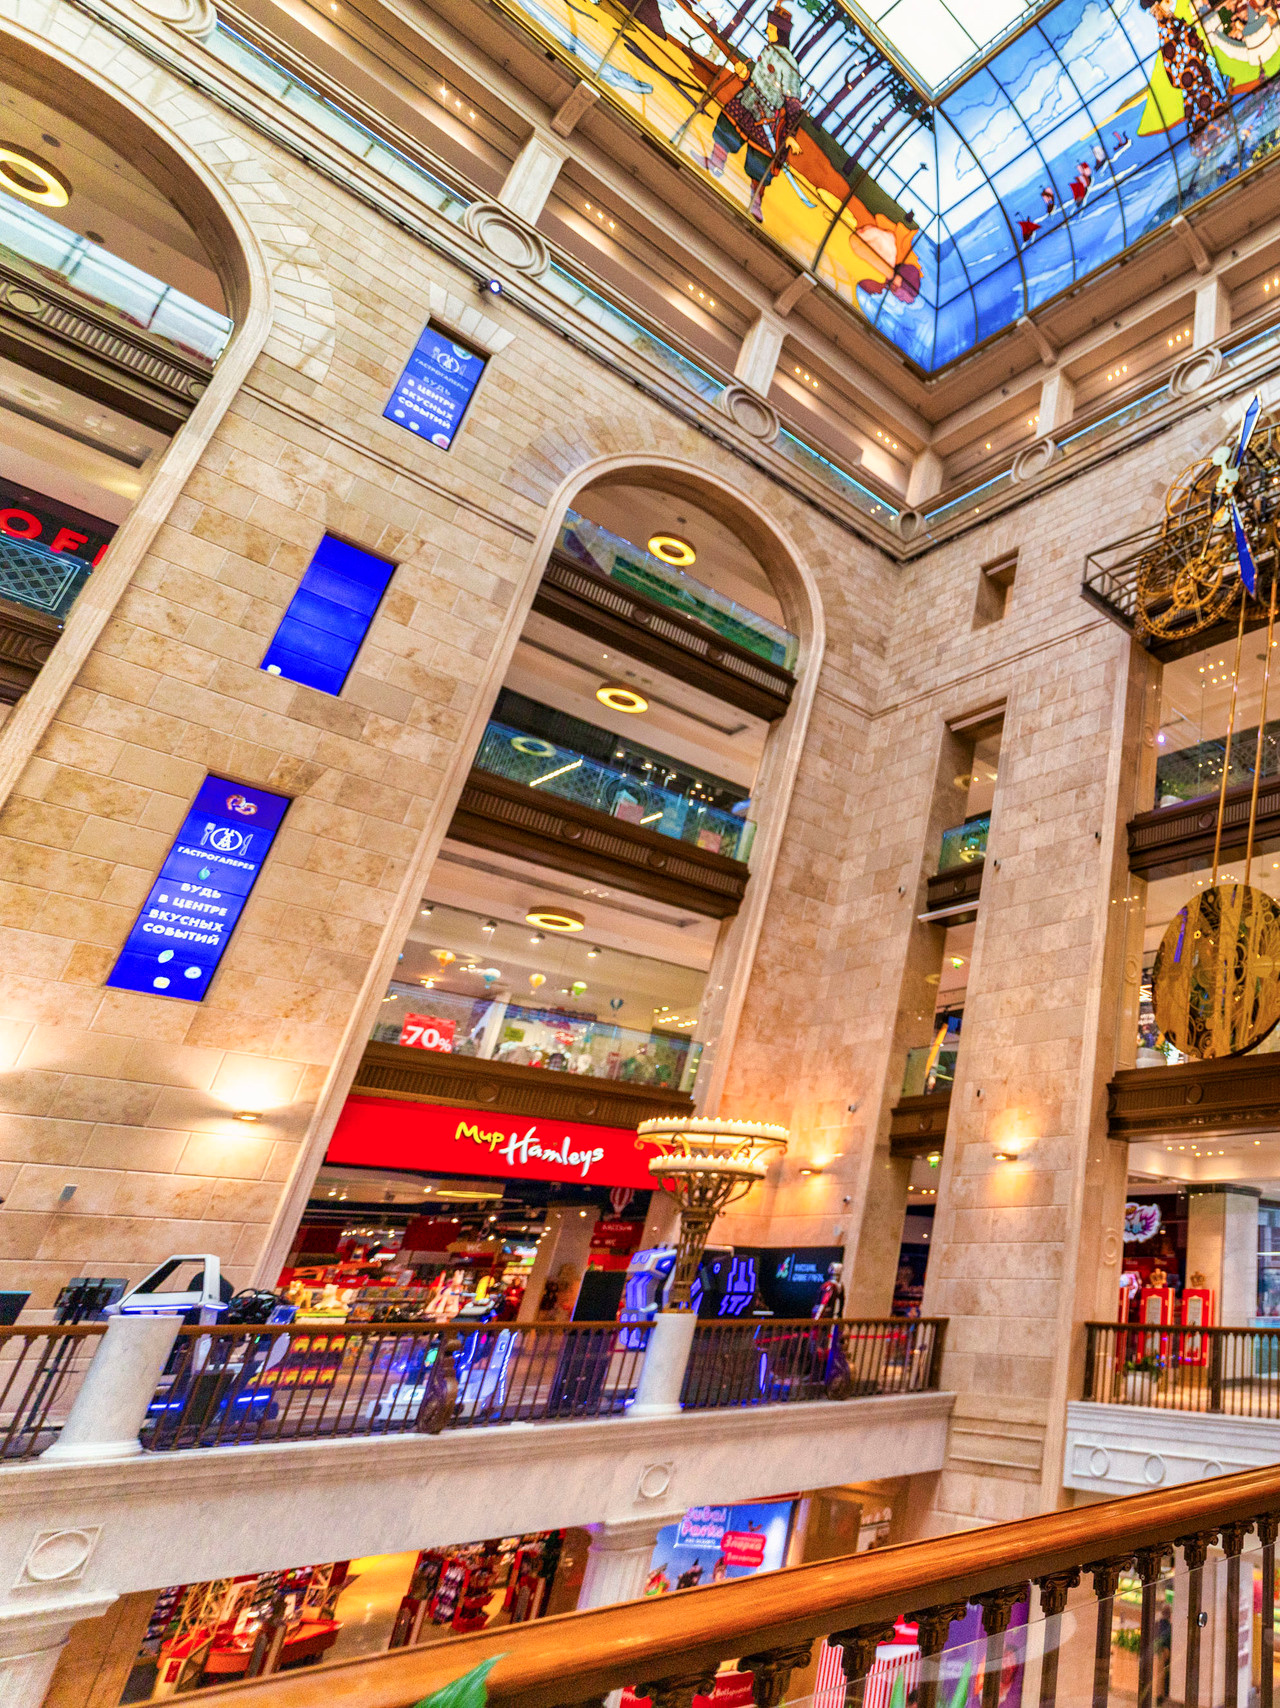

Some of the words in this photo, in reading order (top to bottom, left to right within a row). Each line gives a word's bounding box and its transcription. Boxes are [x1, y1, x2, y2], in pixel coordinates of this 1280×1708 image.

[415, 358, 469, 392] ГАСТРОГАЛЕРЕЯ
[423, 376, 451, 396] БУДЬ
[401, 387, 454, 421] ВКУСНЫХ
[407, 379, 415, 387] В
[417, 385, 456, 411] ЦЕНТРЕ
[397, 396, 451, 429] СОБЫТИЙ
[177, 846, 256, 871] ГАСТРОГАЛЕРЕЯ
[180, 883, 222, 899] БУДЬ
[158, 894, 168, 903] В
[172, 897, 228, 917] ЦЕНТРЕ
[142, 922, 220, 946] СОБЫТИЙ
[148, 909, 224, 933] ВКУСНЫХ
[402, 1025, 452, 1052] -70%
[498, 1126, 604, 1177] Hamleys
